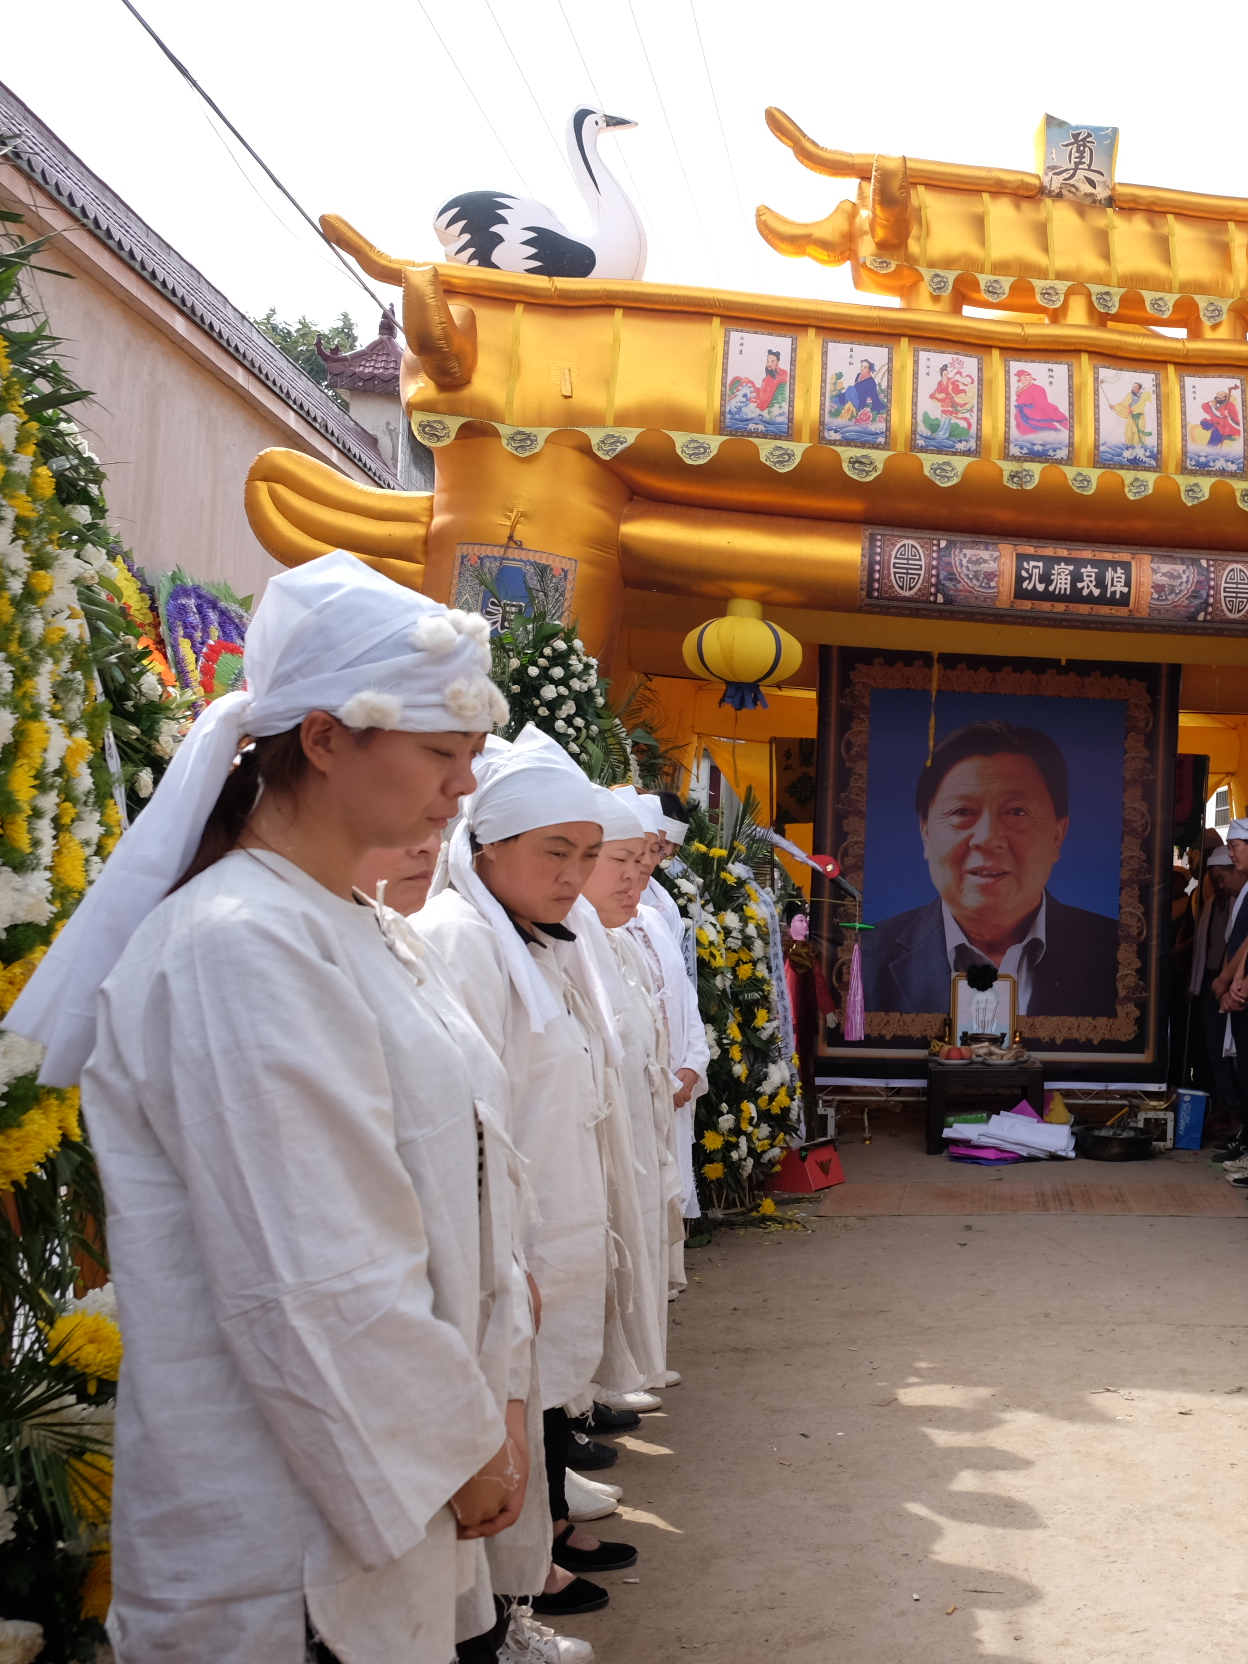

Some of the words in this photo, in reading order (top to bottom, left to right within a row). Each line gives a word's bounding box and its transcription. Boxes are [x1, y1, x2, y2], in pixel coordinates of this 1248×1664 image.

[1051, 129, 1105, 191] 奠
[1020, 560, 1130, 600] 沉痛哀悼
